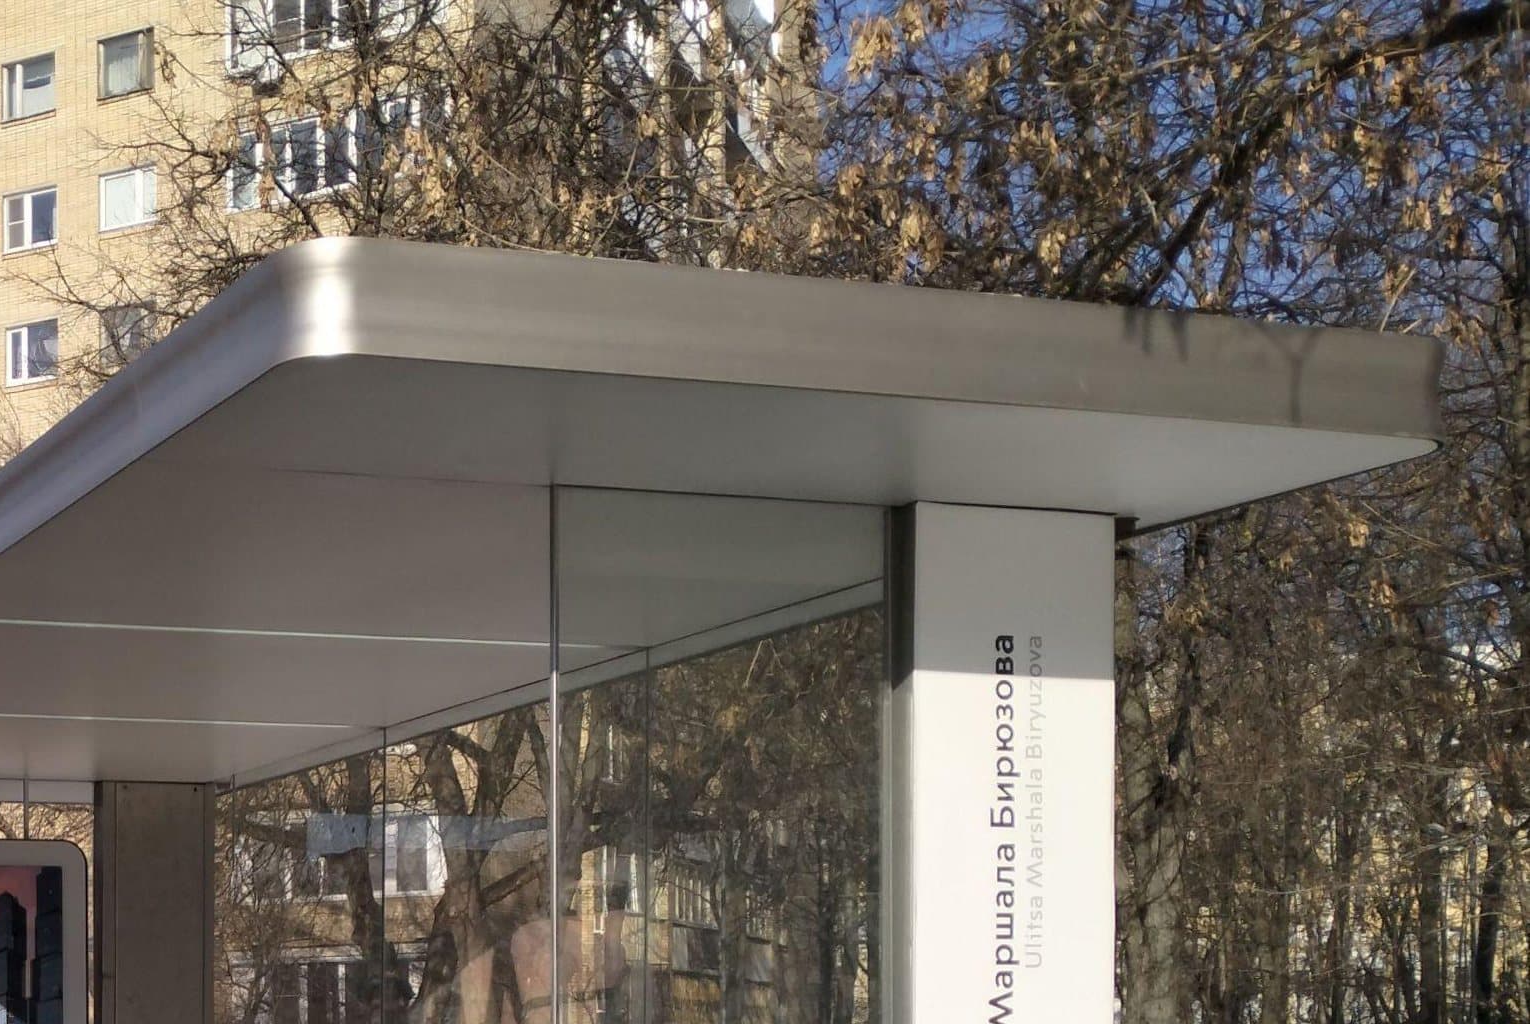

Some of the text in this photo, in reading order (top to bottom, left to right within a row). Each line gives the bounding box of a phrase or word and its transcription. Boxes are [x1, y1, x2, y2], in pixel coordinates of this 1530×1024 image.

[989, 635, 1021, 829] Бирюзова
[1025, 635, 1046, 968] Ulitsa Marshala Biryuzova
